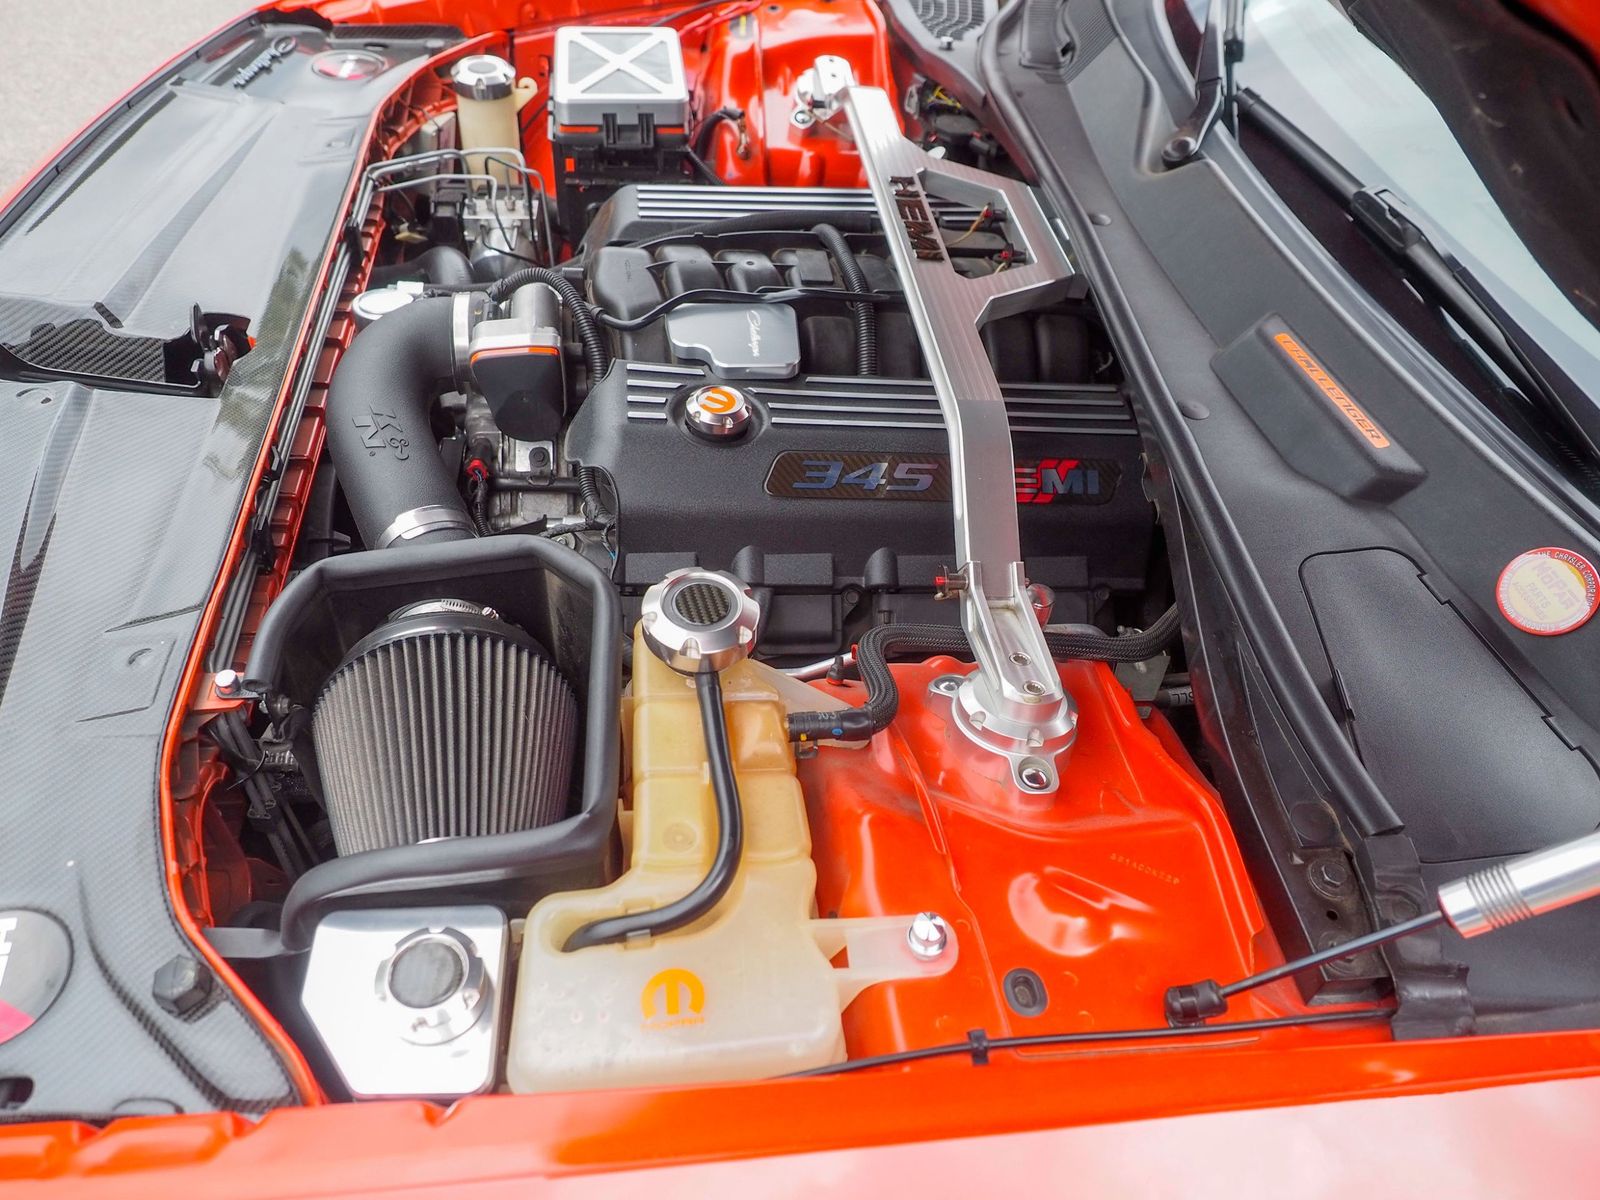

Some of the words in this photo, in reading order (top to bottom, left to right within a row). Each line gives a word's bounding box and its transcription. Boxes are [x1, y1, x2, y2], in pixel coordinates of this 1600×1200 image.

[889, 176, 945, 262] HEMI
[1282, 339, 1382, 440] CHALLENGER
[792, 459, 939, 492] 345
[1014, 466, 1100, 496] EMI
[1554, 551, 1586, 571] CHRYSLER
